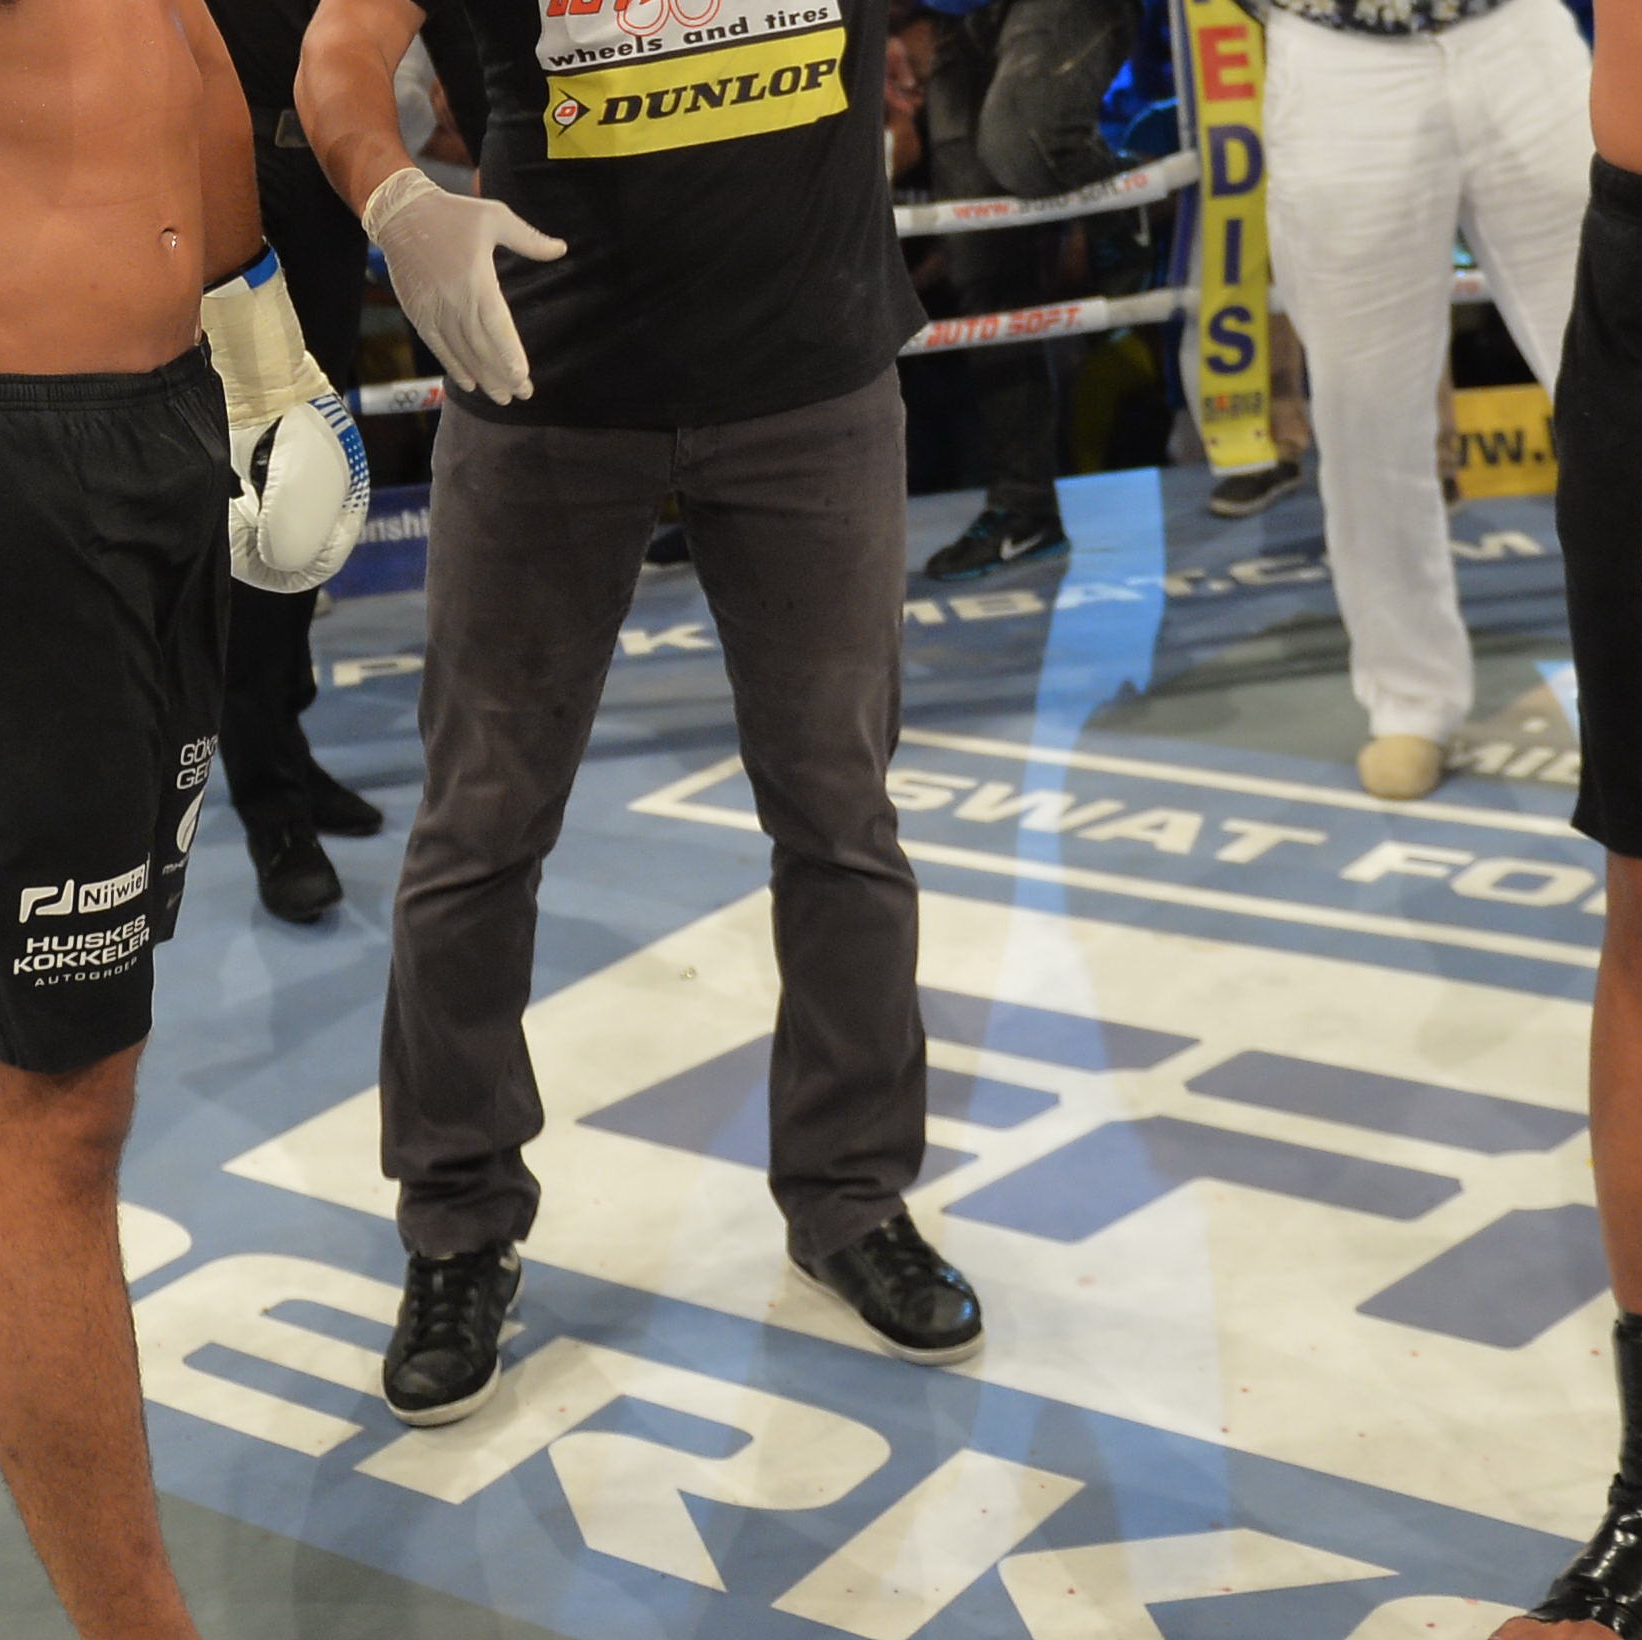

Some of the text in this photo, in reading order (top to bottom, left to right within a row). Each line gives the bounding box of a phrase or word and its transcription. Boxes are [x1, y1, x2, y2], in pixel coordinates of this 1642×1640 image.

[548, 7, 829, 67] wheels and tires
[597, 57, 838, 127] DUNLOP
[885, 765, 1329, 866] SWAT
[13, 926, 150, 976] KOKKELER
[26, 914, 146, 954] HUISKES
[34, 956, 138, 987] AUTOGROEP
